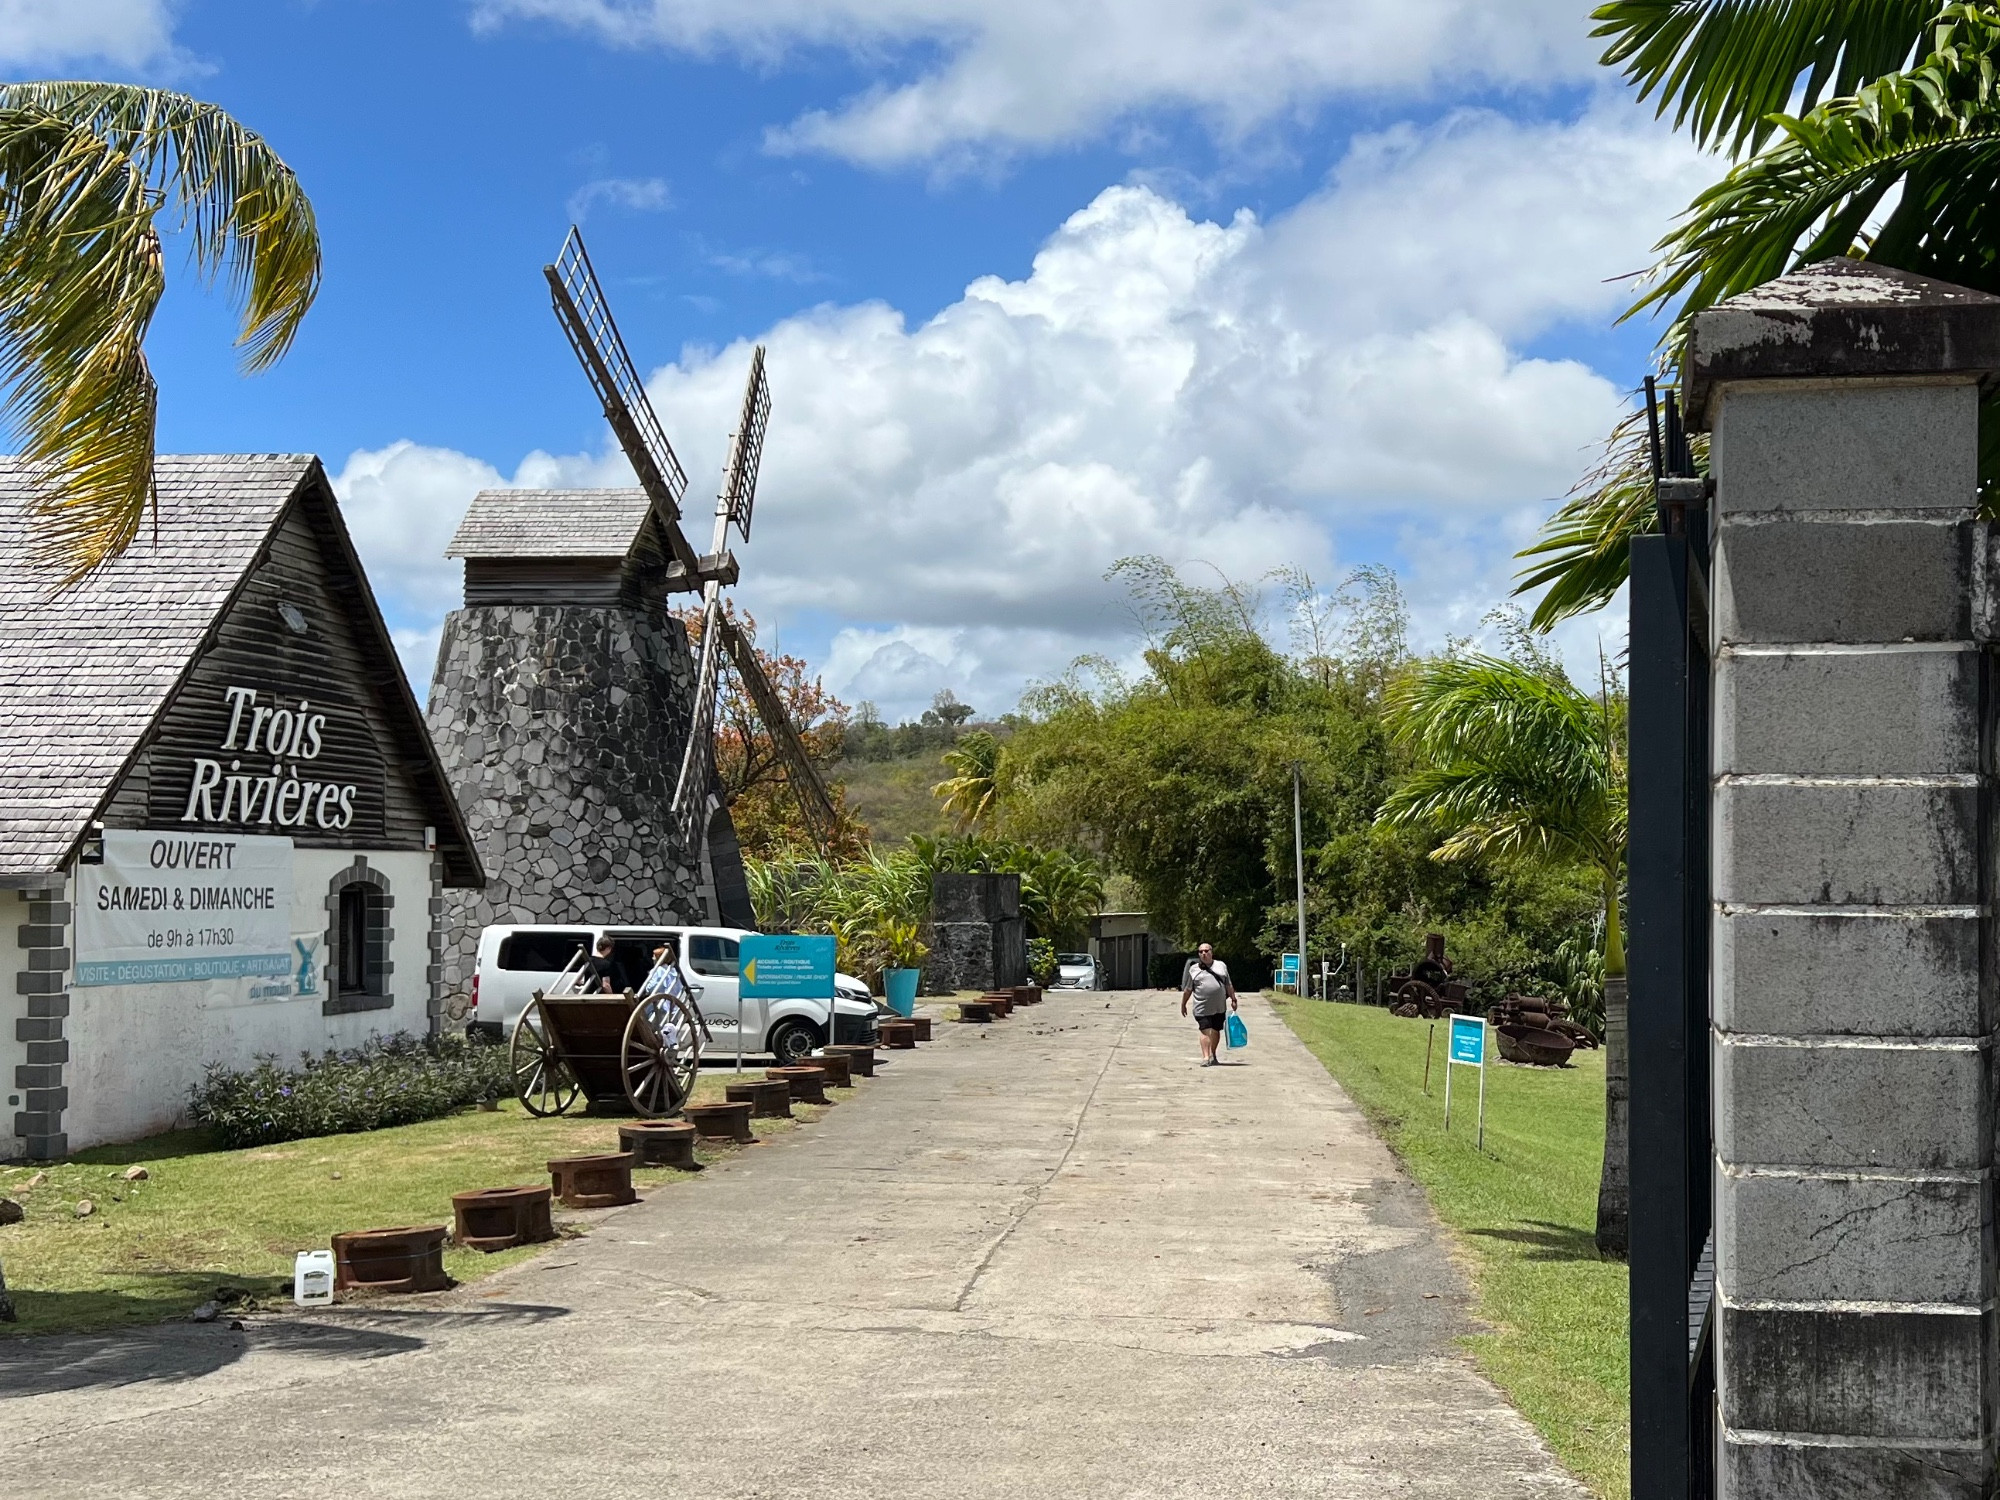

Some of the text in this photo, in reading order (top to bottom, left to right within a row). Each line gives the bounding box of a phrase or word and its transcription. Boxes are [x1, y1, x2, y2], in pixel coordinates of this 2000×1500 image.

[220, 686, 326, 760] Trois
[181, 758, 357, 830] Rivières
[150, 839, 237, 869] OUVERT
[97, 885, 275, 911] SAMEDI & DIMANCHE
[147, 928, 234, 948] de 9h à 17h30
[79, 957, 291, 982] VISITE DÉGUSTATION BOUTIQUE ARTISANAT
[250, 984, 261, 998] du
